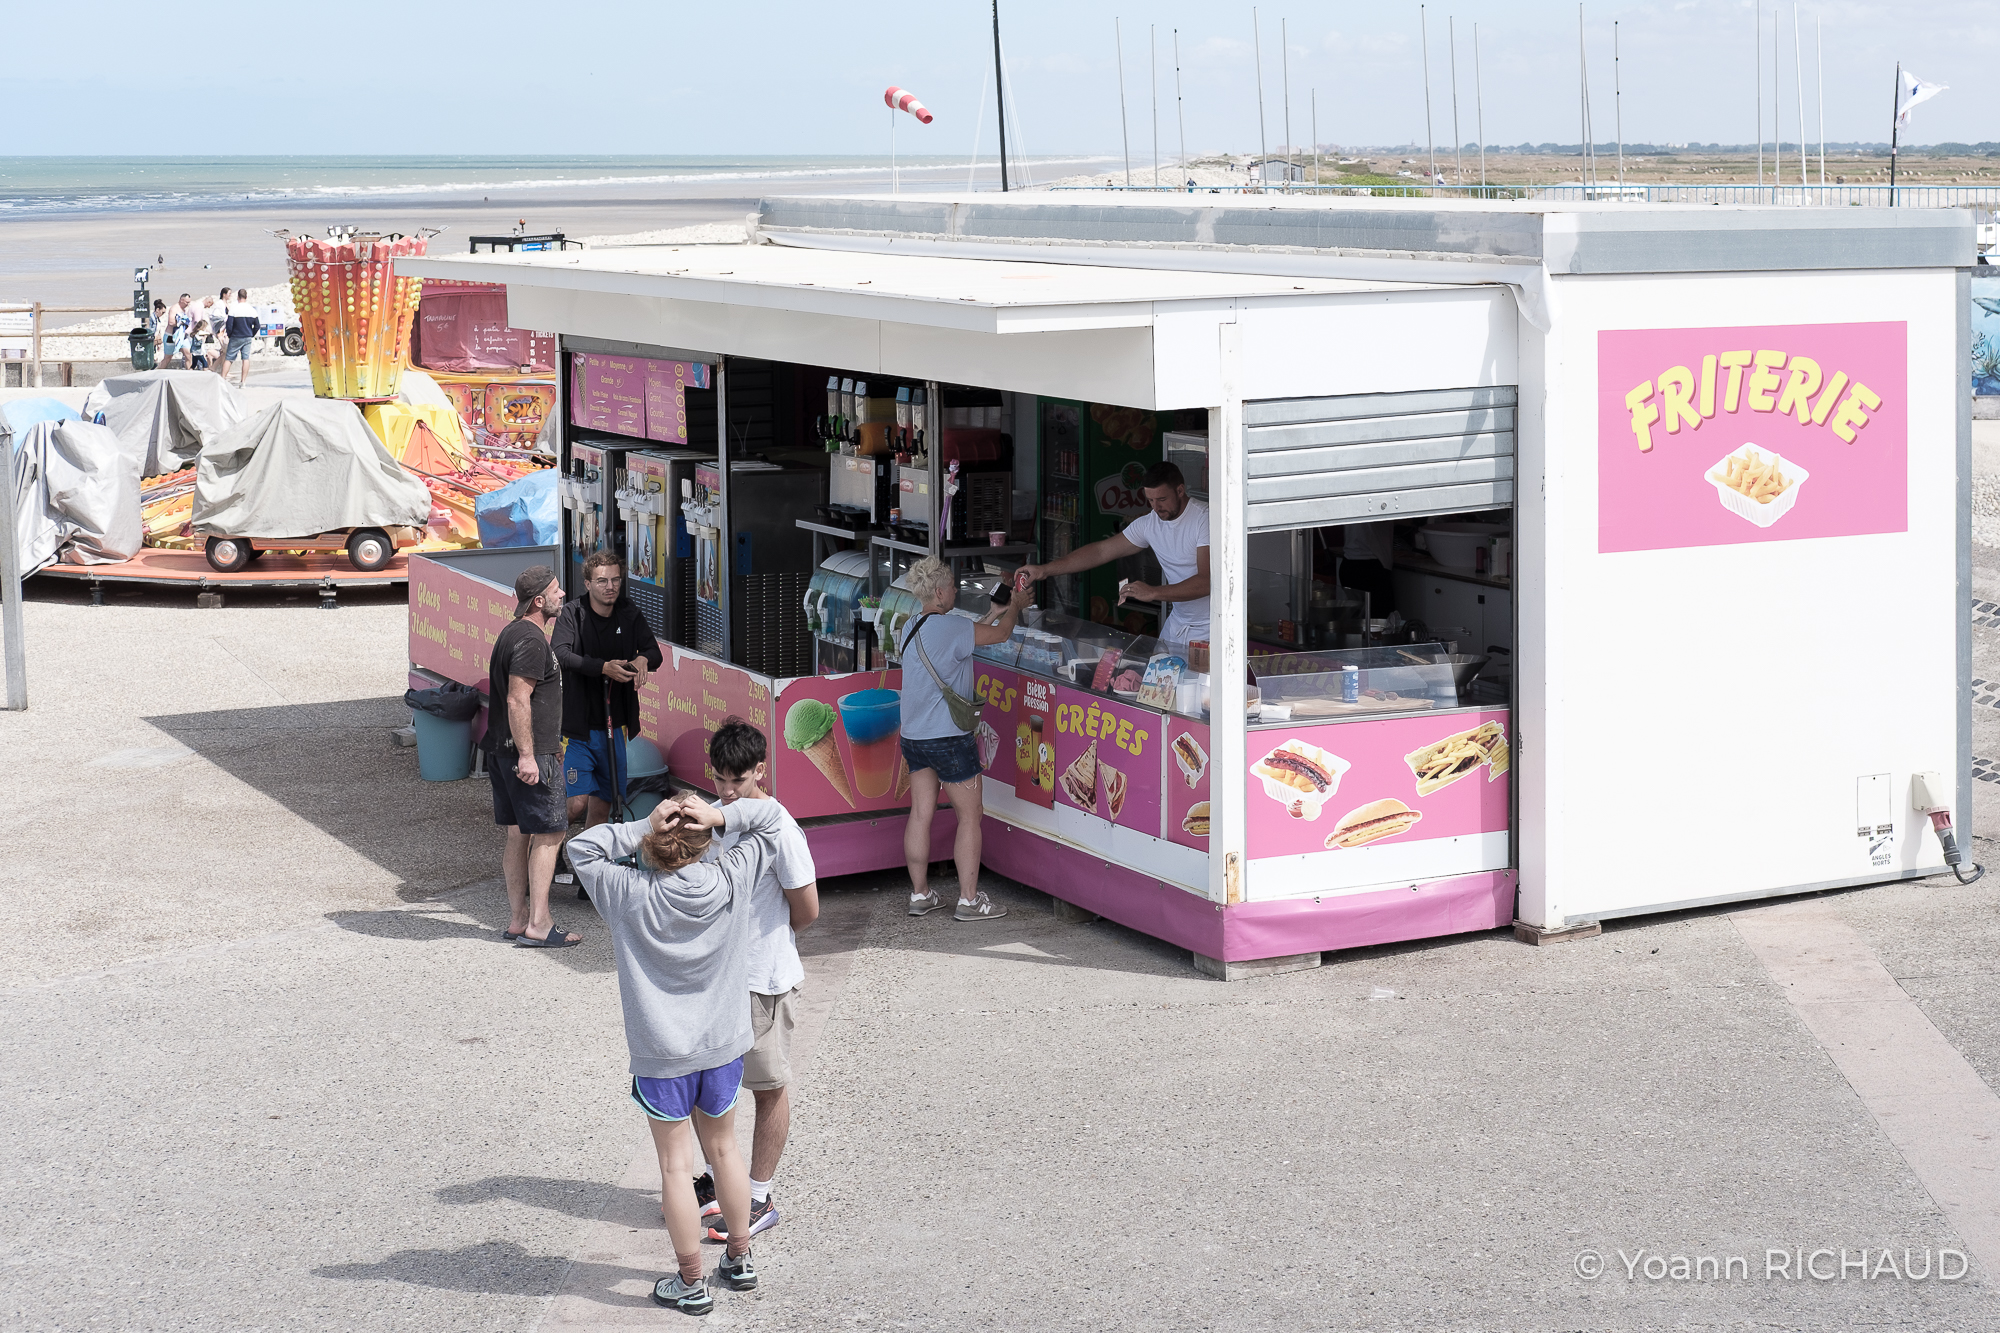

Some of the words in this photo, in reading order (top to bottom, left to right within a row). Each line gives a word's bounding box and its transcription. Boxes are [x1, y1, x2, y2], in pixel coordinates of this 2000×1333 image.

[529, 339, 536, 347] 10
[535, 331, 554, 339] TICKETS
[529, 348, 536, 356] 15
[1625, 349, 1883, 453] FRITERIE
[1101, 485, 1154, 510] Oas
[417, 582, 441, 612] Glaces
[448, 588, 460, 605] Petite
[467, 595, 479, 612] 2,50€
[411, 612, 448, 648] Italiennes
[448, 616, 466, 635] Moyenne
[467, 623, 480, 640] 3,50€
[448, 644, 463, 661] Grande
[473, 653, 480, 668] 5€
[702, 664, 719, 685] Petite
[748, 680, 766, 702] 2,50€
[1253, 649, 1342, 695] HICHIS
[667, 690, 698, 717] Granita
[976, 674, 1018, 713] CES
[702, 689, 727, 713] Moyenne
[748, 706, 767, 728] 3,50€
[1055, 701, 1149, 756] CRÊPES
[1871, 853, 1892, 861] ANGLES
[1872, 859, 1891, 867] MORTS
